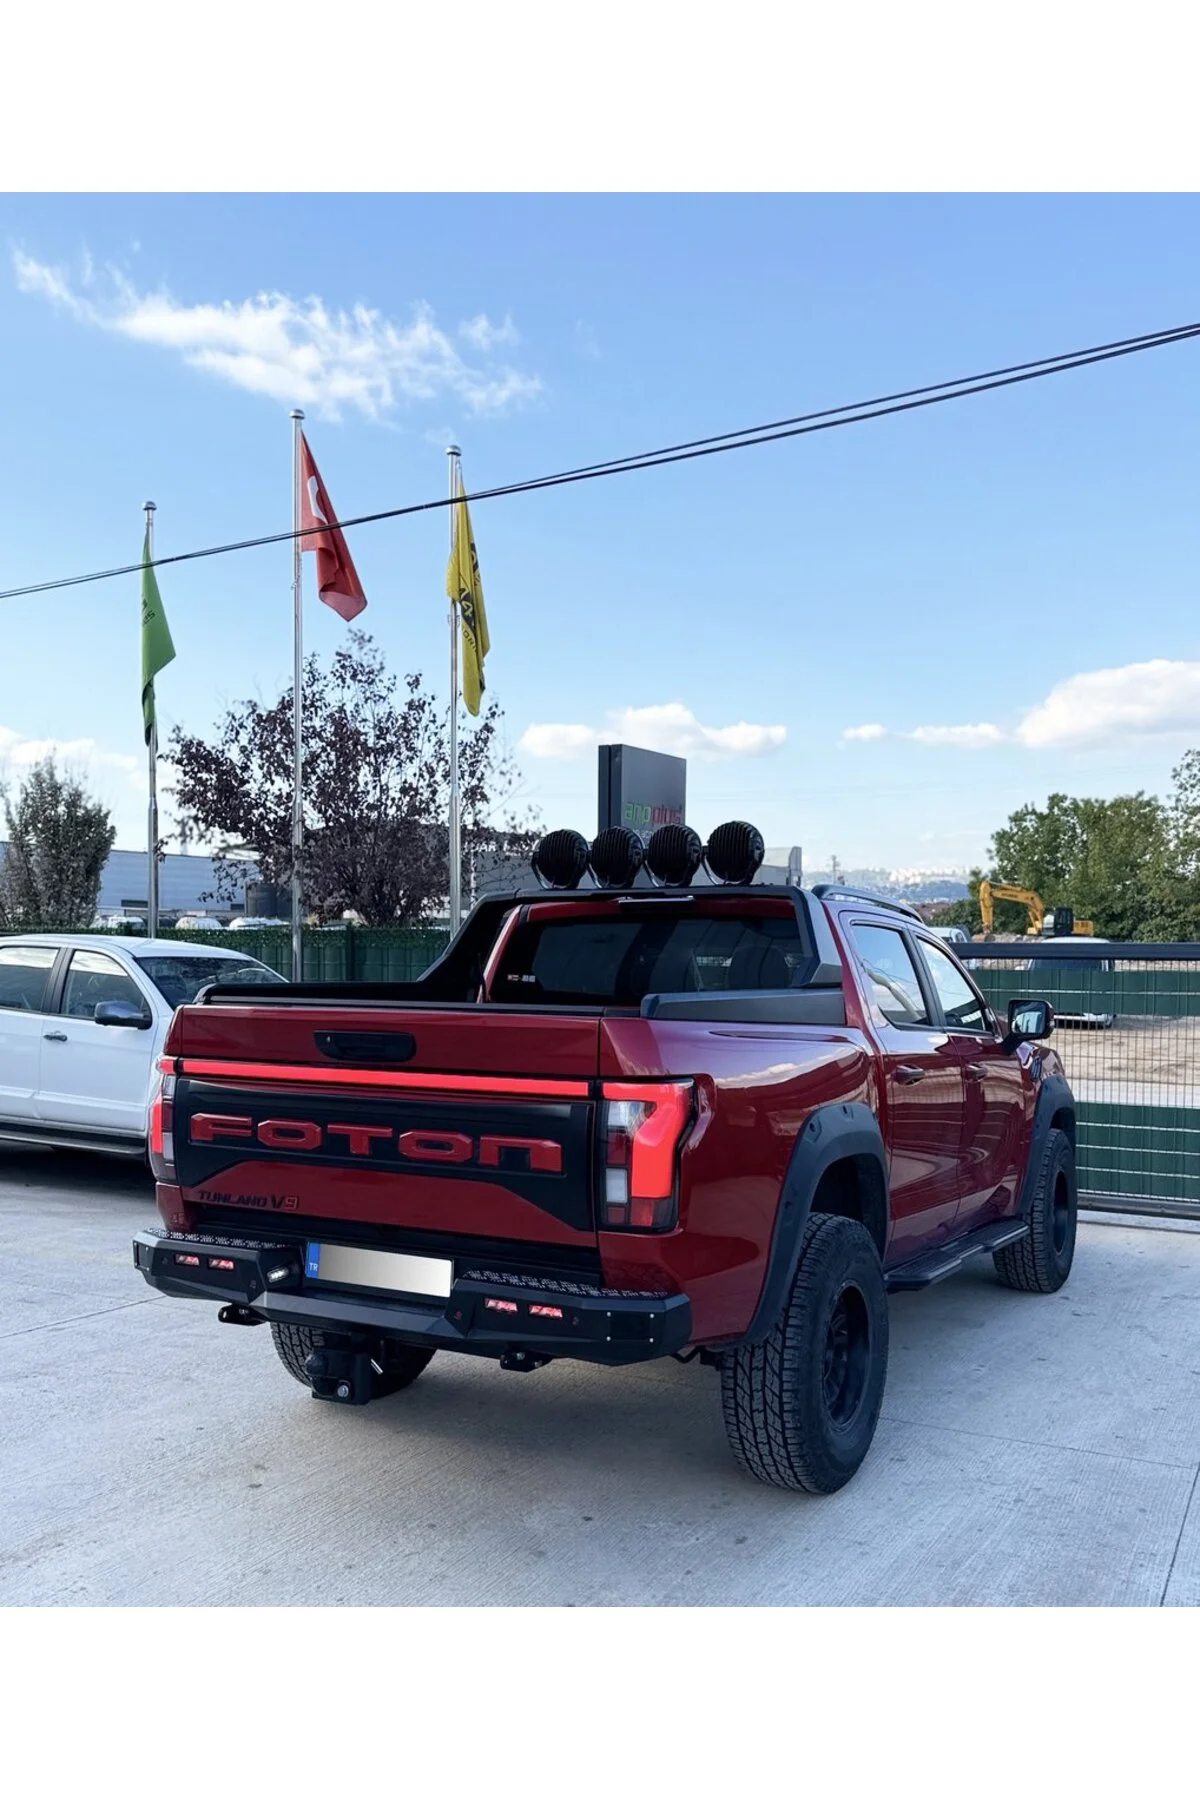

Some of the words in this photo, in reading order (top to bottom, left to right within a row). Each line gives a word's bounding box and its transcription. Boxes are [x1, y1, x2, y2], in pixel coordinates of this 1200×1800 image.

[190, 1112, 562, 1173] FOTON
[199, 1190, 268, 1207] TUNLAND
[271, 1193, 300, 1210] V9
[308, 1261, 319, 1273] TR
